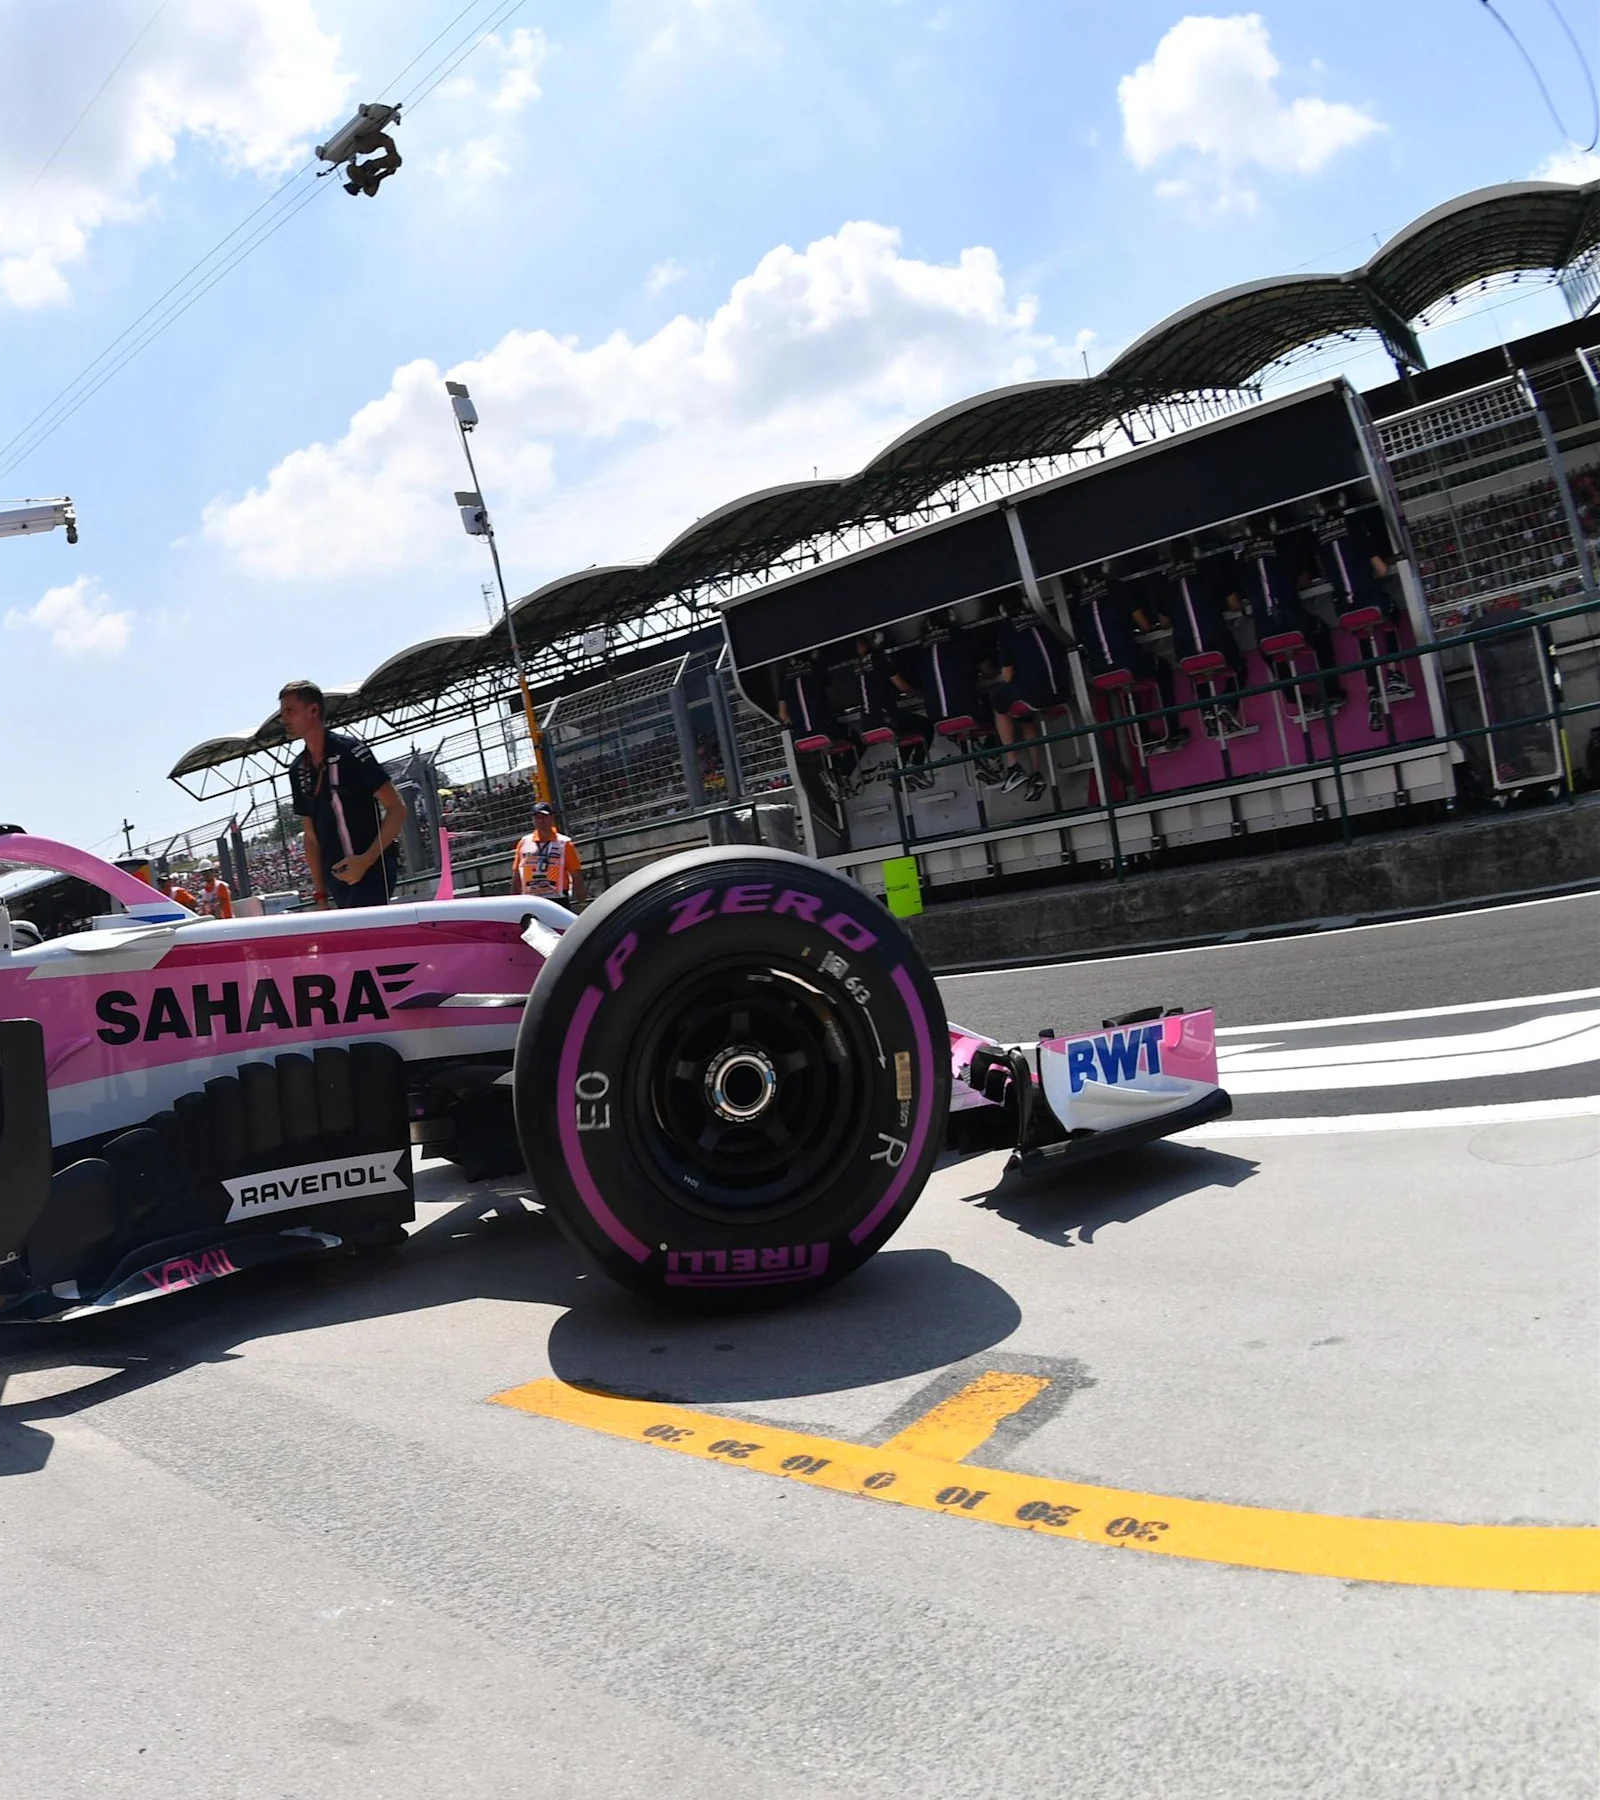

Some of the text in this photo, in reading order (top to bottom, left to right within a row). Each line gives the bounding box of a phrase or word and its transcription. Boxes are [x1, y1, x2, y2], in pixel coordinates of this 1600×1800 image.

[605, 882, 879, 992] P ZERO
[95, 968, 391, 1046] SAHARA
[1067, 1023, 1164, 1094] BWT
[869, 1131, 908, 1168] R
[665, 1242, 830, 1288] PIRELLI
[642, 1424, 695, 1443] 30
[708, 1439, 765, 1459] 20
[780, 1454, 832, 1476] 10
[863, 1471, 897, 1490] 0
[935, 1486, 991, 1510] 10
[1105, 1516, 1169, 1542] 30
